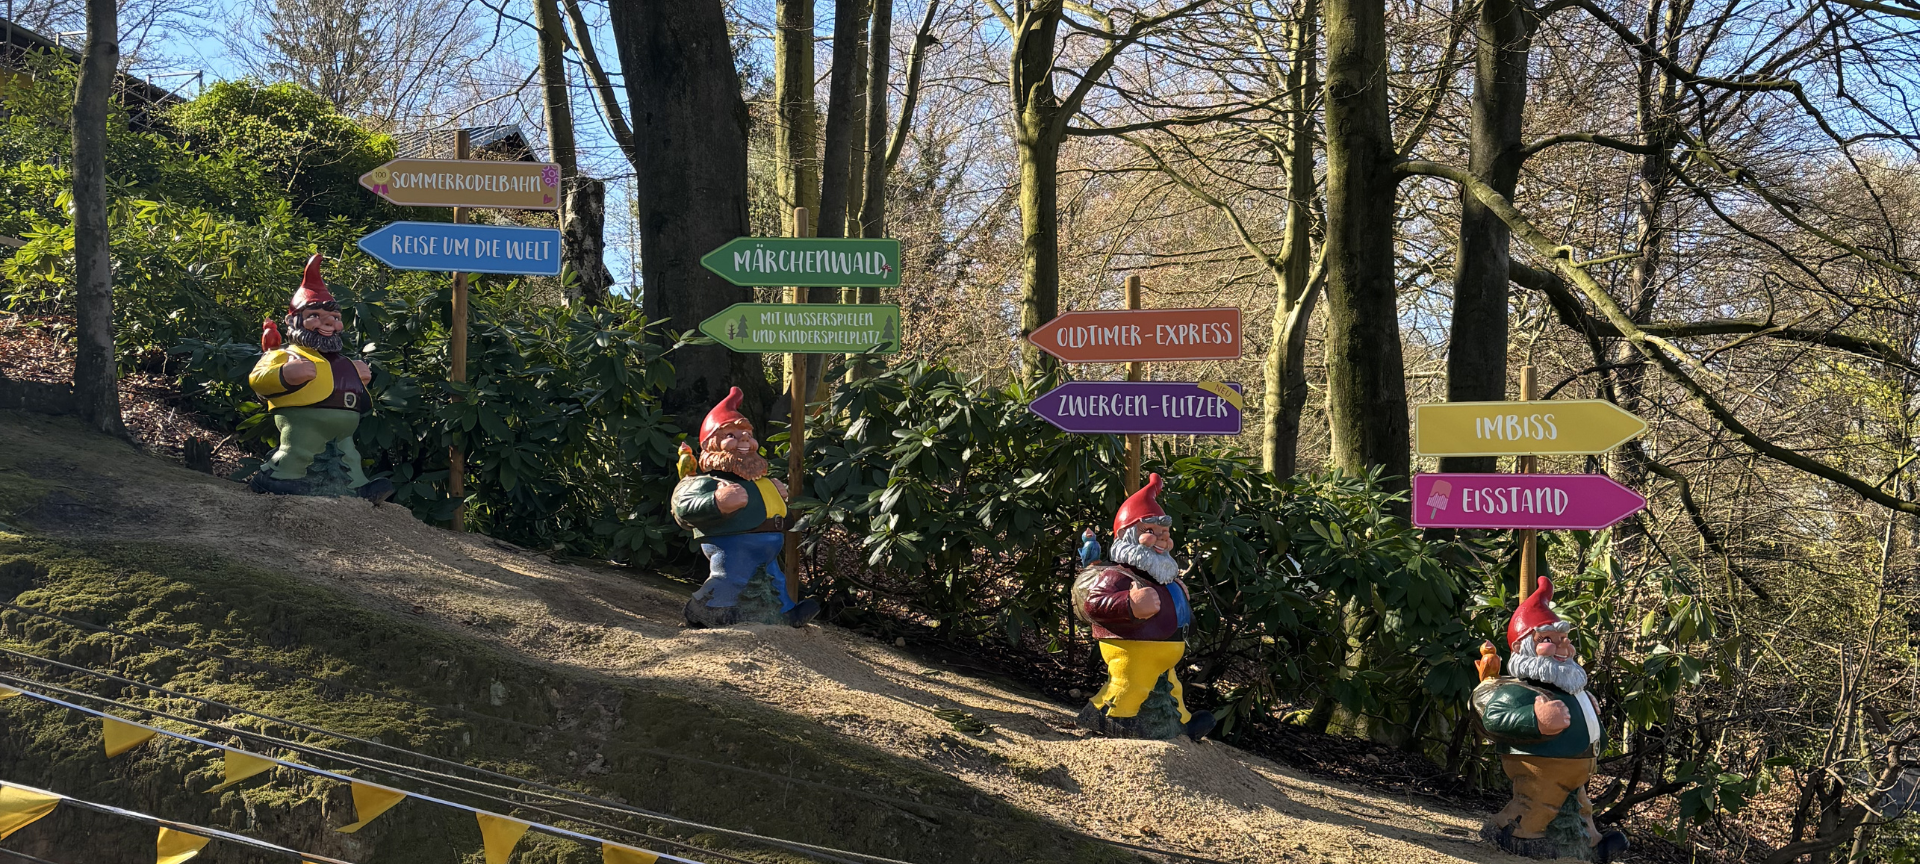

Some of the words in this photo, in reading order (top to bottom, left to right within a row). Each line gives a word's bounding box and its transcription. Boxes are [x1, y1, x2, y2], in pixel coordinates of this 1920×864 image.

[391, 171, 541, 192] SOMMERRODELBAHN
[391, 234, 438, 255] REISE
[443, 237, 469, 257] UM
[475, 239, 501, 259] DIE
[507, 240, 551, 261] WELT
[734, 244, 886, 275] MÄRCHENWALD
[760, 312, 781, 325] MIT
[784, 312, 873, 326] WASSERSPIELEN
[752, 330, 776, 343] UND
[779, 330, 880, 344] KINDERSPIELPLATZ
[1056, 323, 1232, 348] OLDTIMER-EXPRESS
[1214, 384, 1232, 398] NEU
[1058, 393, 1228, 418] ZWERGEN-FLITZER
[1476, 414, 1557, 441] IMBISS
[1463, 487, 1568, 515] EISSTAND
